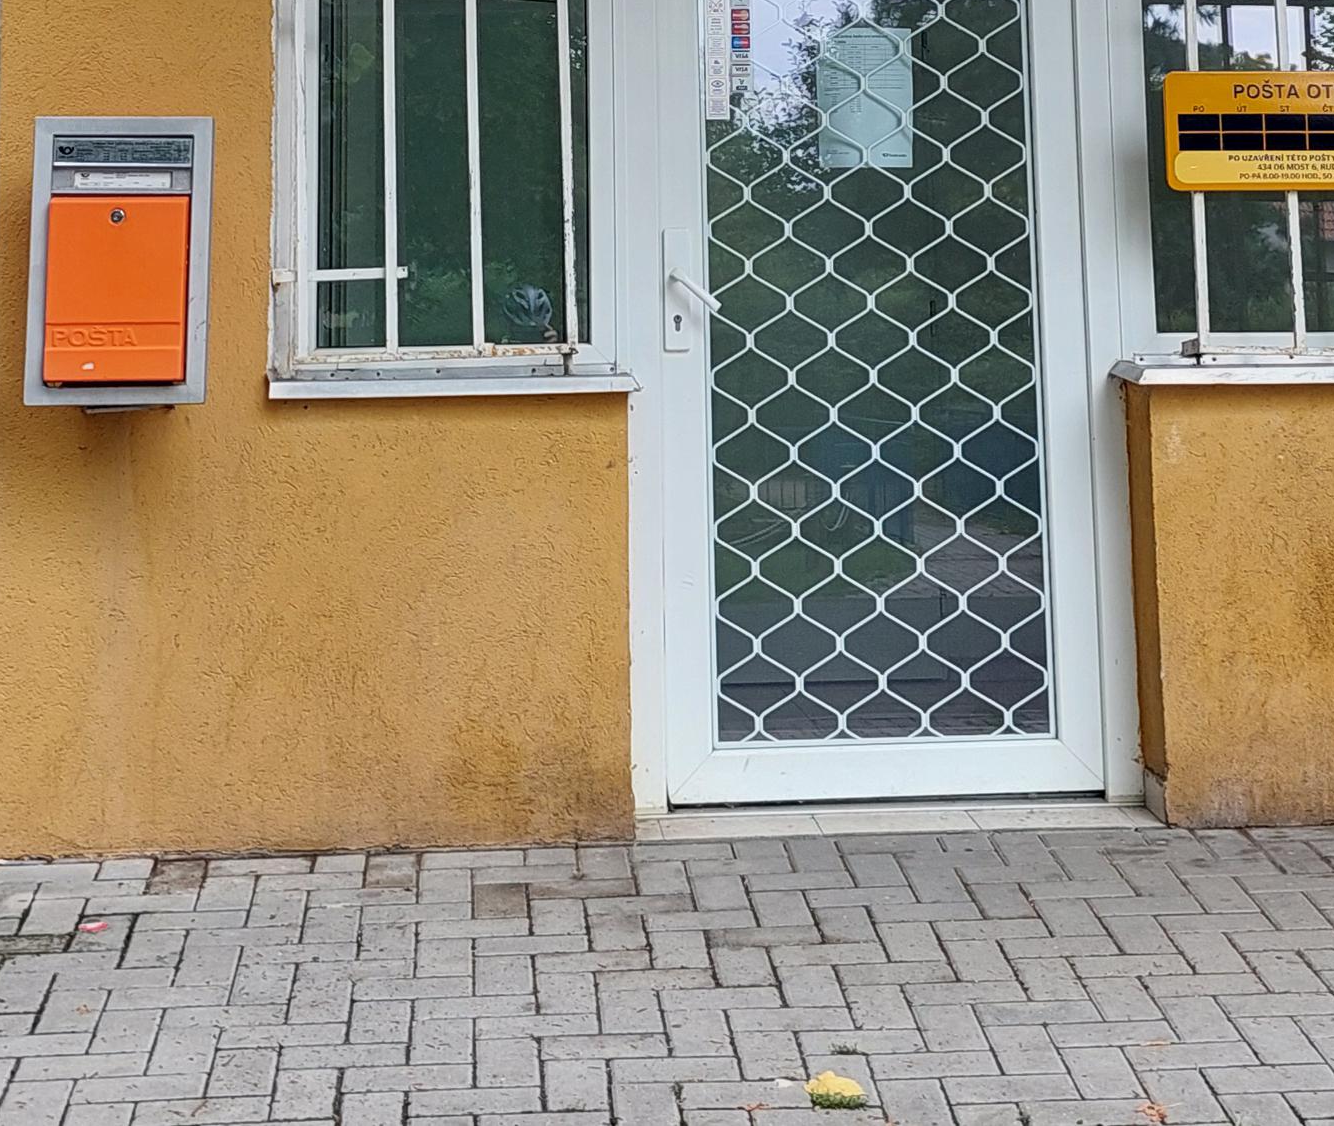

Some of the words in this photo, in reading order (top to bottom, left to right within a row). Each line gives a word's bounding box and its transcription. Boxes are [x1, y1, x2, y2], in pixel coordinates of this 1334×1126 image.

[1233, 79, 1300, 99] POŠTA
[1193, 105, 1205, 113] PO
[1236, 104, 1247, 113] ÚT
[1279, 105, 1290, 113] ST
[1322, 104, 1334, 112] ČT
[1228, 154, 1240, 162] PO
[1242, 153, 1284, 162] UZAVŘENÍ
[1286, 153, 1308, 162] TÉTO
[1257, 163, 1272, 171] 434
[1273, 163, 1285, 171] 06
[1286, 163, 1309, 171] MOST
[1239, 172, 1261, 180] PO-PÁ
[51, 326, 138, 348] POŠTA
